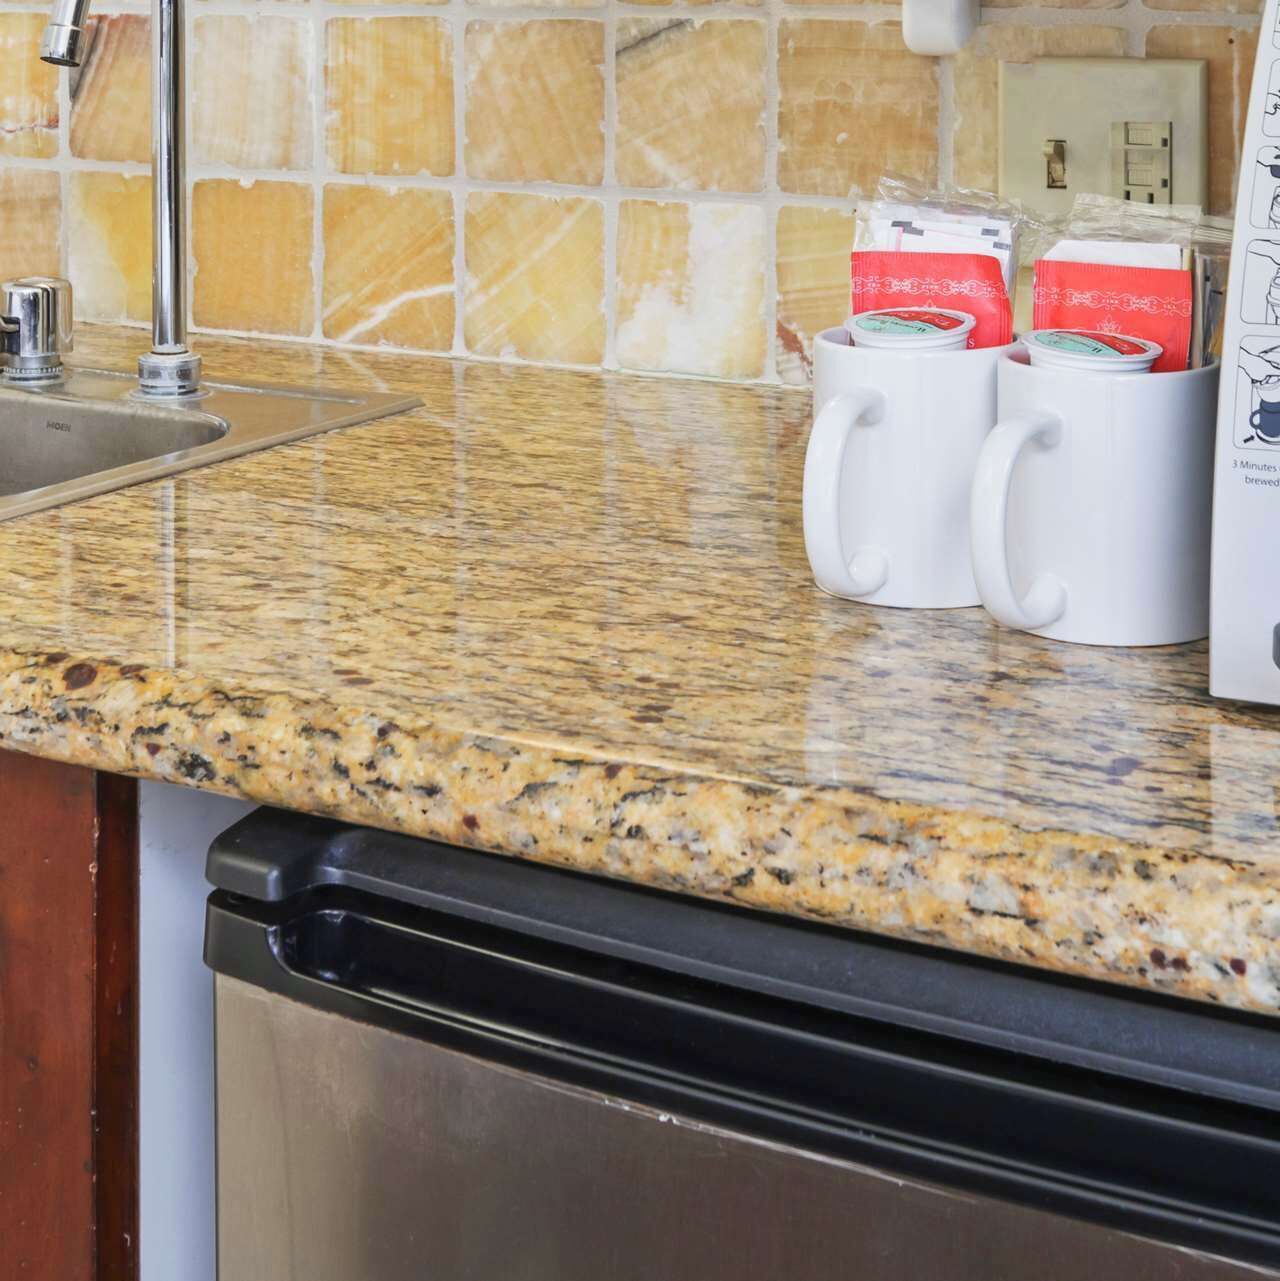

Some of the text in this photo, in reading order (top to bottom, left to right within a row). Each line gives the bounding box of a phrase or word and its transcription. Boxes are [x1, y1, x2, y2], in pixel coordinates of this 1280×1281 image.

[46, 420, 71, 432] MOEN
[1232, 459, 1238, 468] 3
[1240, 460, 1277, 472] Minutes
[1245, 476, 1280, 487] brewed
